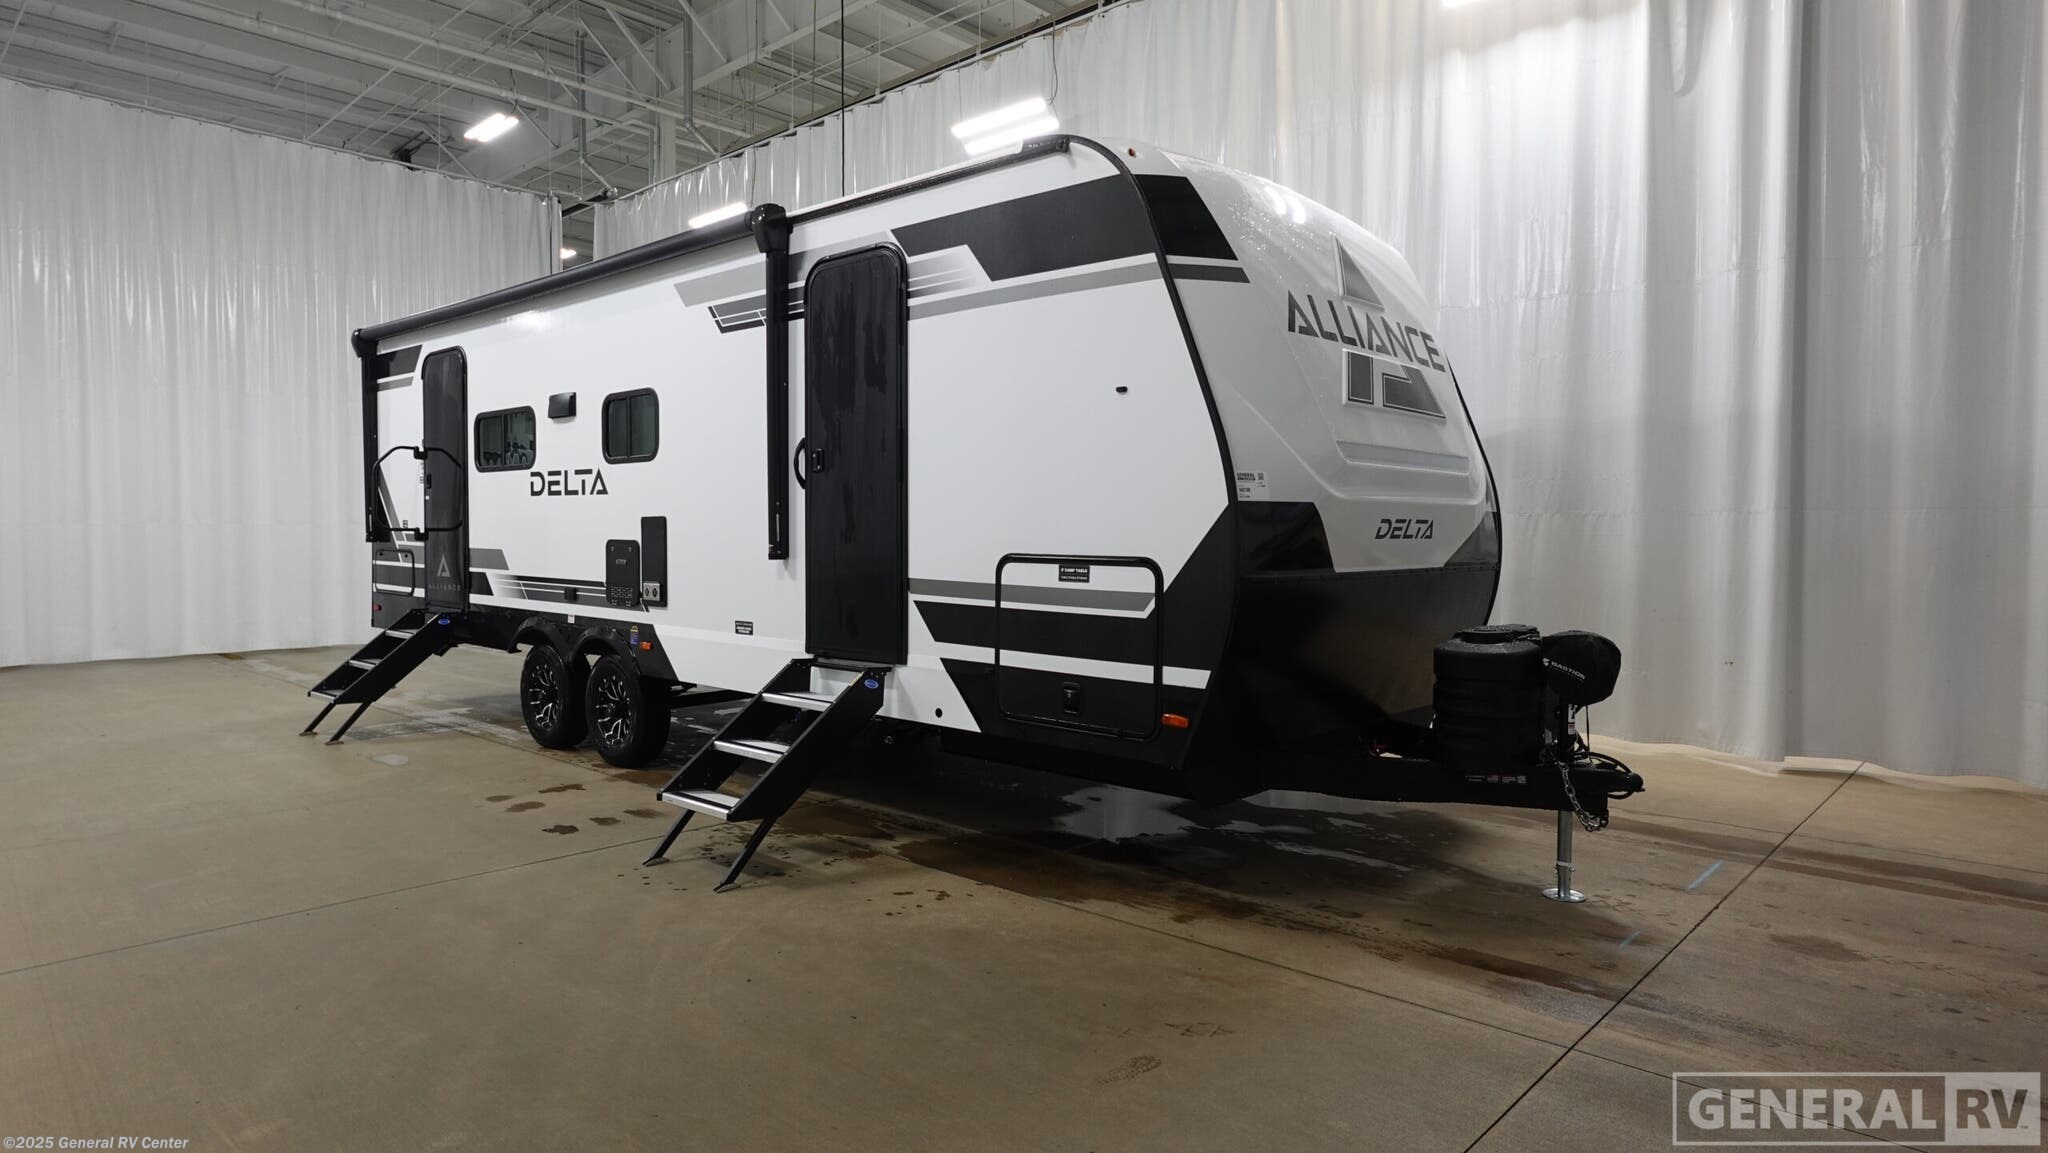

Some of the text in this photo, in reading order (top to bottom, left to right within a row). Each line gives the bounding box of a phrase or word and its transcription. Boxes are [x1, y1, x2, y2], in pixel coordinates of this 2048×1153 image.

[1287, 289, 1446, 373] ALLIANCE
[529, 468, 609, 497] DELTA
[1374, 518, 1434, 540] DELTA
[1551, 661, 1586, 680] BASTION
